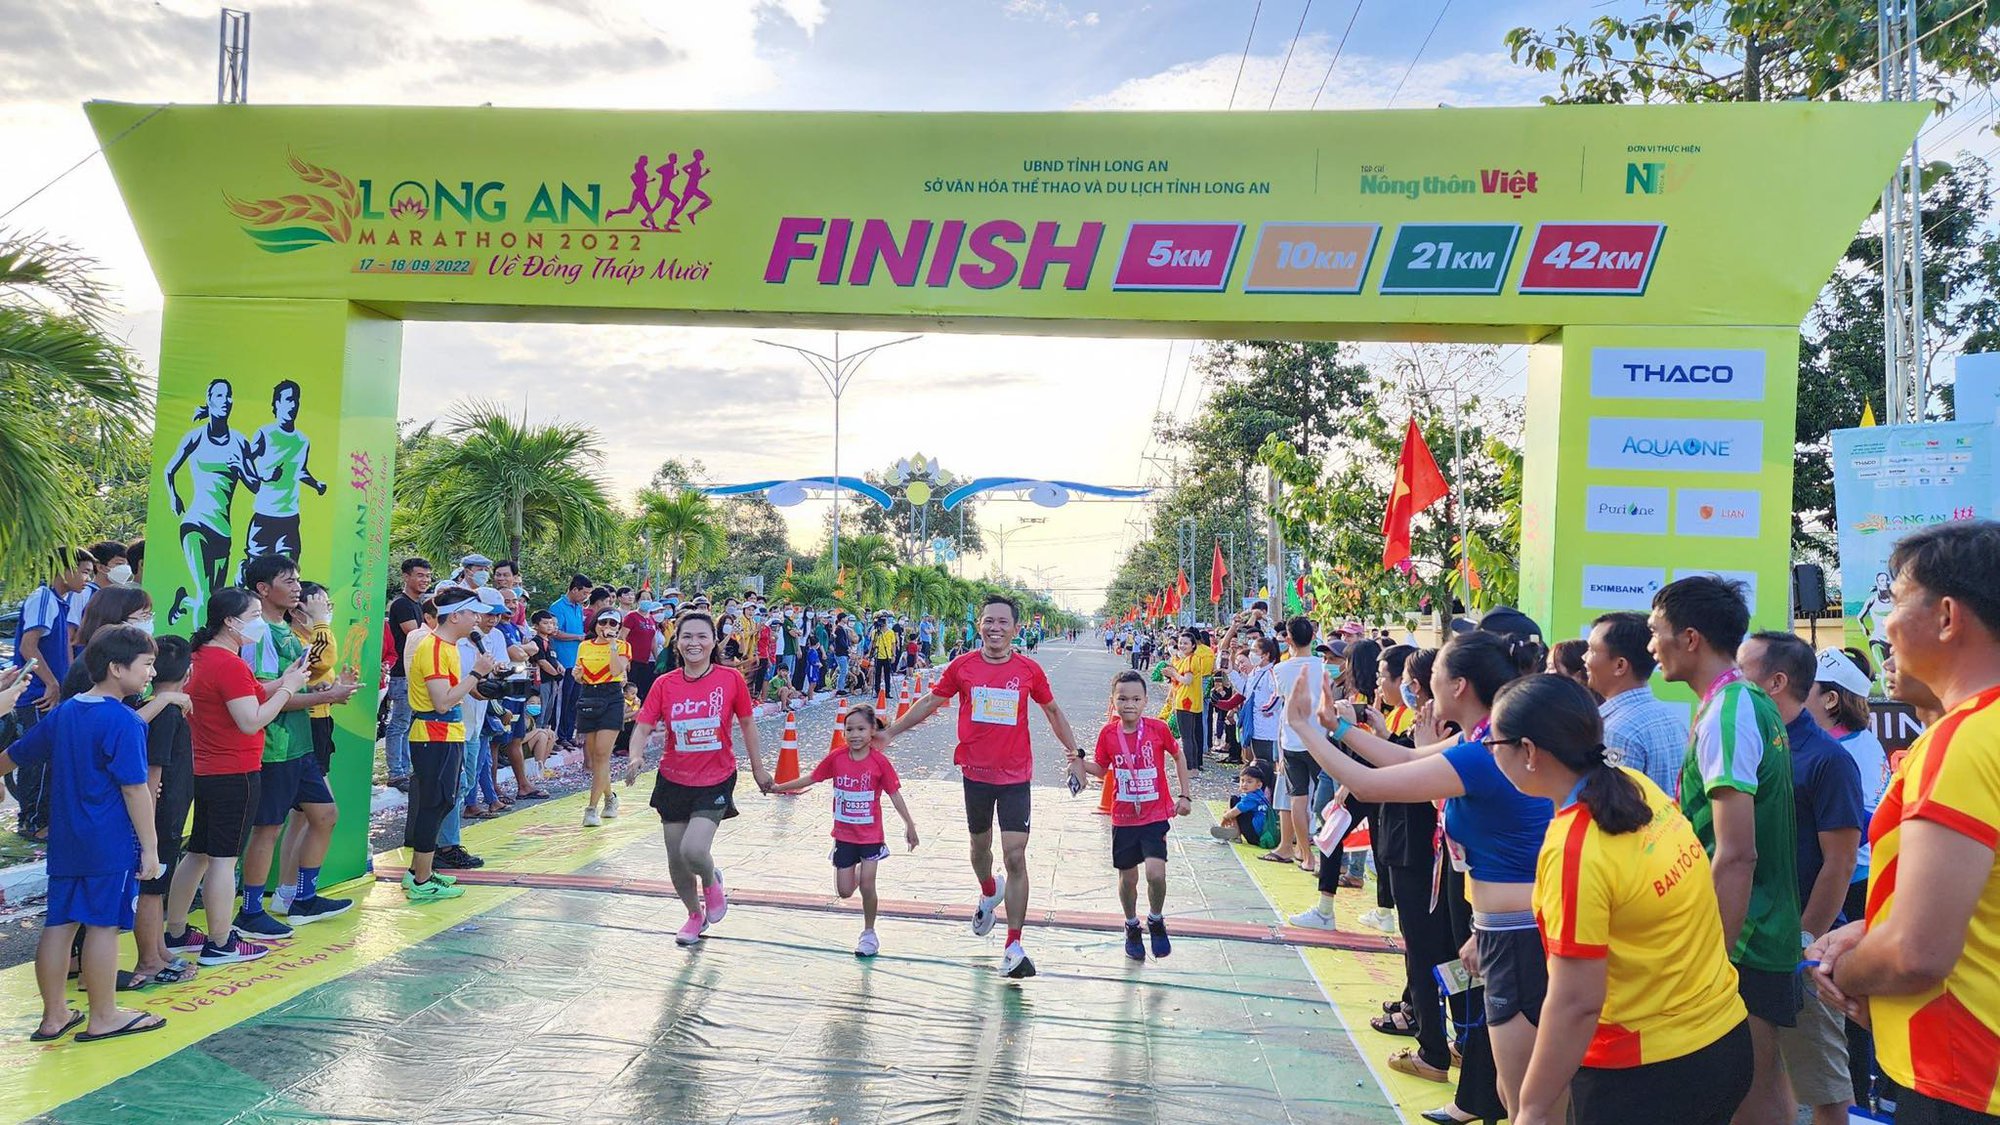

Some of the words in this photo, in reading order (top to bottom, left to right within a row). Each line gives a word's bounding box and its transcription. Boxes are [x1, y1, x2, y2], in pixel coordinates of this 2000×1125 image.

[1023, 160, 1064, 172] UBND
[1067, 157, 1100, 172] TỈNH
[1104, 160, 1144, 173] LONG
[1148, 160, 1168, 172] AN
[924, 178, 943, 193] SỞ
[946, 178, 974, 193] VĂN
[979, 178, 1008, 193] HÓA
[1012, 177, 1039, 193] THỂ
[1042, 181, 1079, 193] THAO
[1084, 178, 1101, 193] VÀ
[1107, 181, 1127, 194] DU
[1131, 181, 1163, 197] LỊCH
[1167, 178, 1200, 194] TỈNH
[1205, 182, 1246, 194] LONG
[1250, 182, 1271, 194] AN
[1360, 174, 1420, 200] Nông
[1422, 174, 1476, 195] thôn
[1480, 169, 1538, 199] Việt
[358, 179, 507, 223] LONG
[523, 180, 600, 225] AN
[359, 230, 544, 250] MARATHON
[560, 231, 642, 251] 2022
[763, 216, 1105, 291] FINISH
[1146, 240, 1213, 268] 5KM
[359, 259, 373, 271] 17
[390, 258, 471, 274] 18/09/2022
[1275, 241, 1358, 270] 10KM
[1407, 241, 1496, 270] 21KM
[1542, 241, 1643, 270] 42KM
[488, 254, 519, 278] Về
[522, 254, 584, 284] Đồng
[594, 256, 646, 286] Tháp
[651, 259, 713, 282] Mười
[1623, 364, 1734, 384] THACO
[355, 503, 368, 541] AN
[1721, 509, 1746, 519] LIAN
[1884, 513, 1925, 526] LONG
[1929, 513, 1947, 524] AN
[349, 550, 364, 627] LONG
[1590, 584, 1645, 595] EXIMBANK
[671, 698, 708, 719] ptr
[836, 774, 860, 788] ptr
[1653, 868, 1681, 897] BAN
